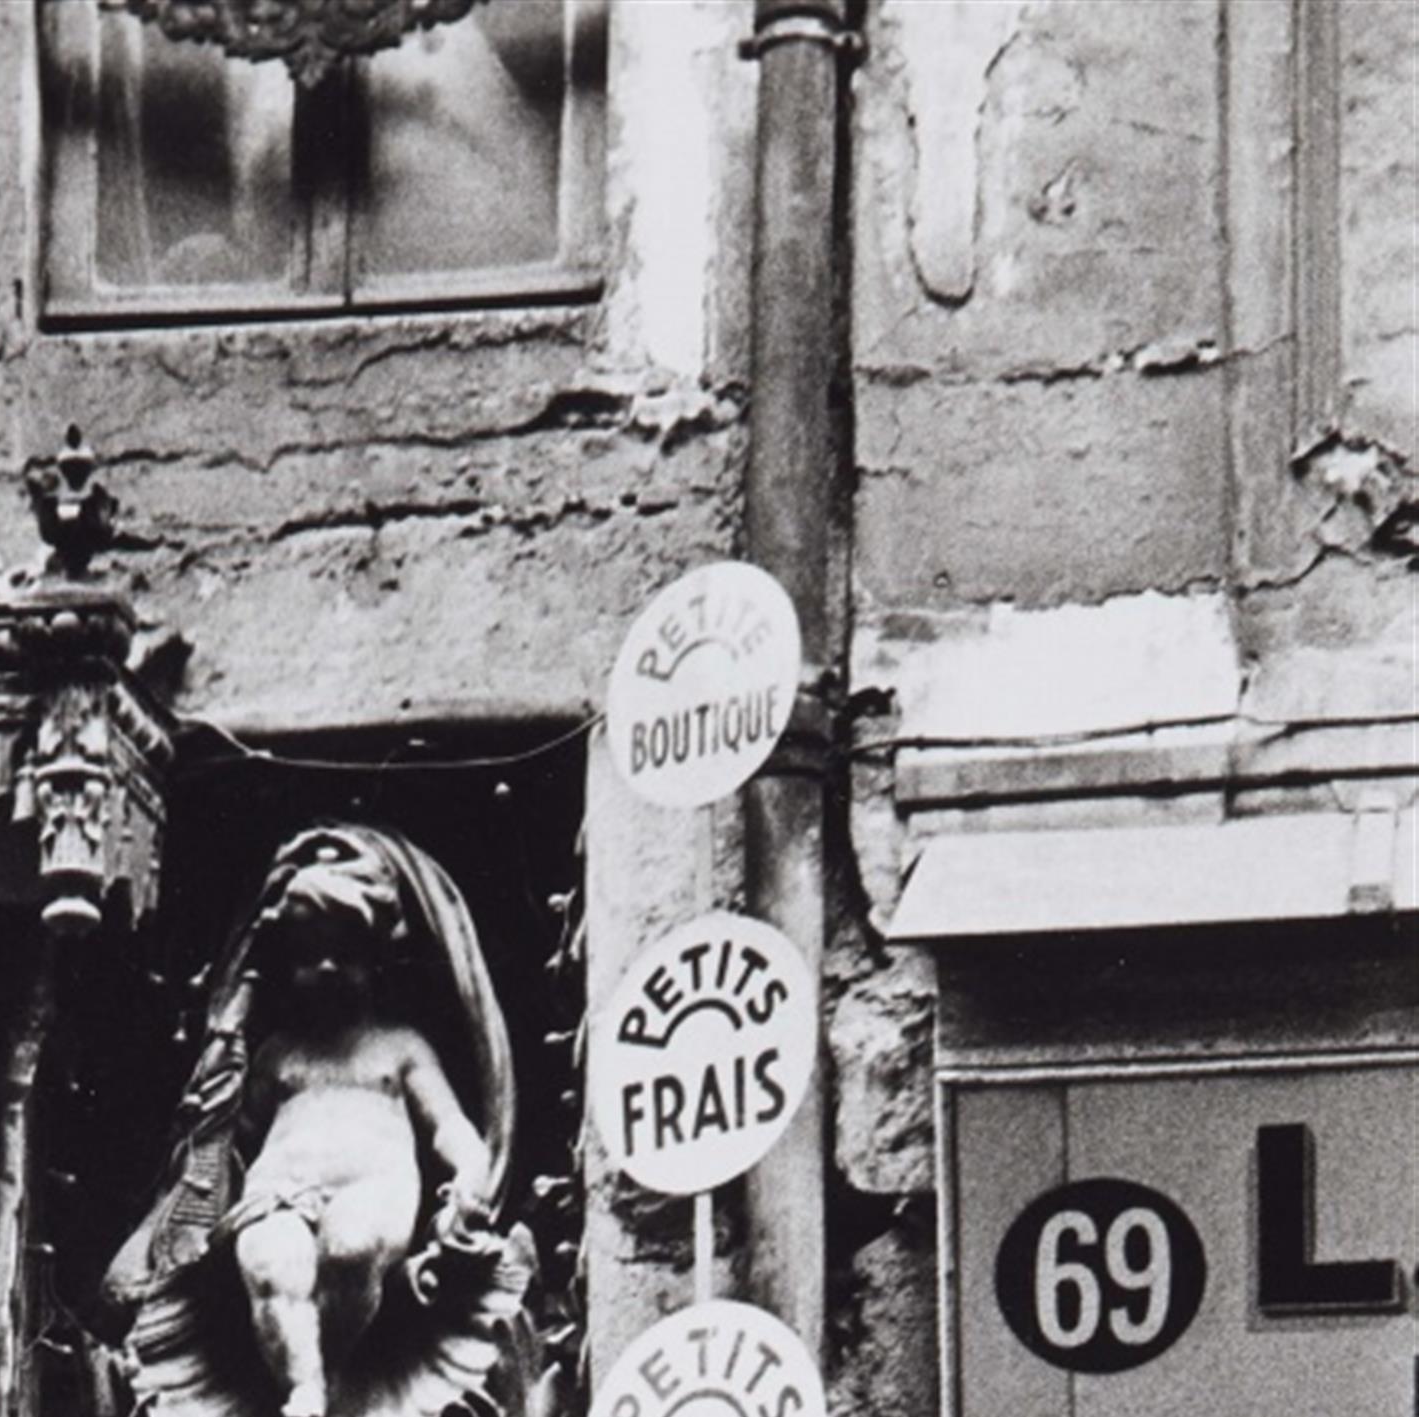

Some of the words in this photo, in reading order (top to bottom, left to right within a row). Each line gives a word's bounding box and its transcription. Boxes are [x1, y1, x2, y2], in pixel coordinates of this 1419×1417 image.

[637, 593, 774, 682] PETITE
[631, 685, 780, 775] BOUTIQUE
[617, 940, 789, 1049] PETITS
[622, 1047, 787, 1157] FRAIS
[1249, 1122, 1419, 1318] L
[1035, 1207, 1172, 1348] 69
